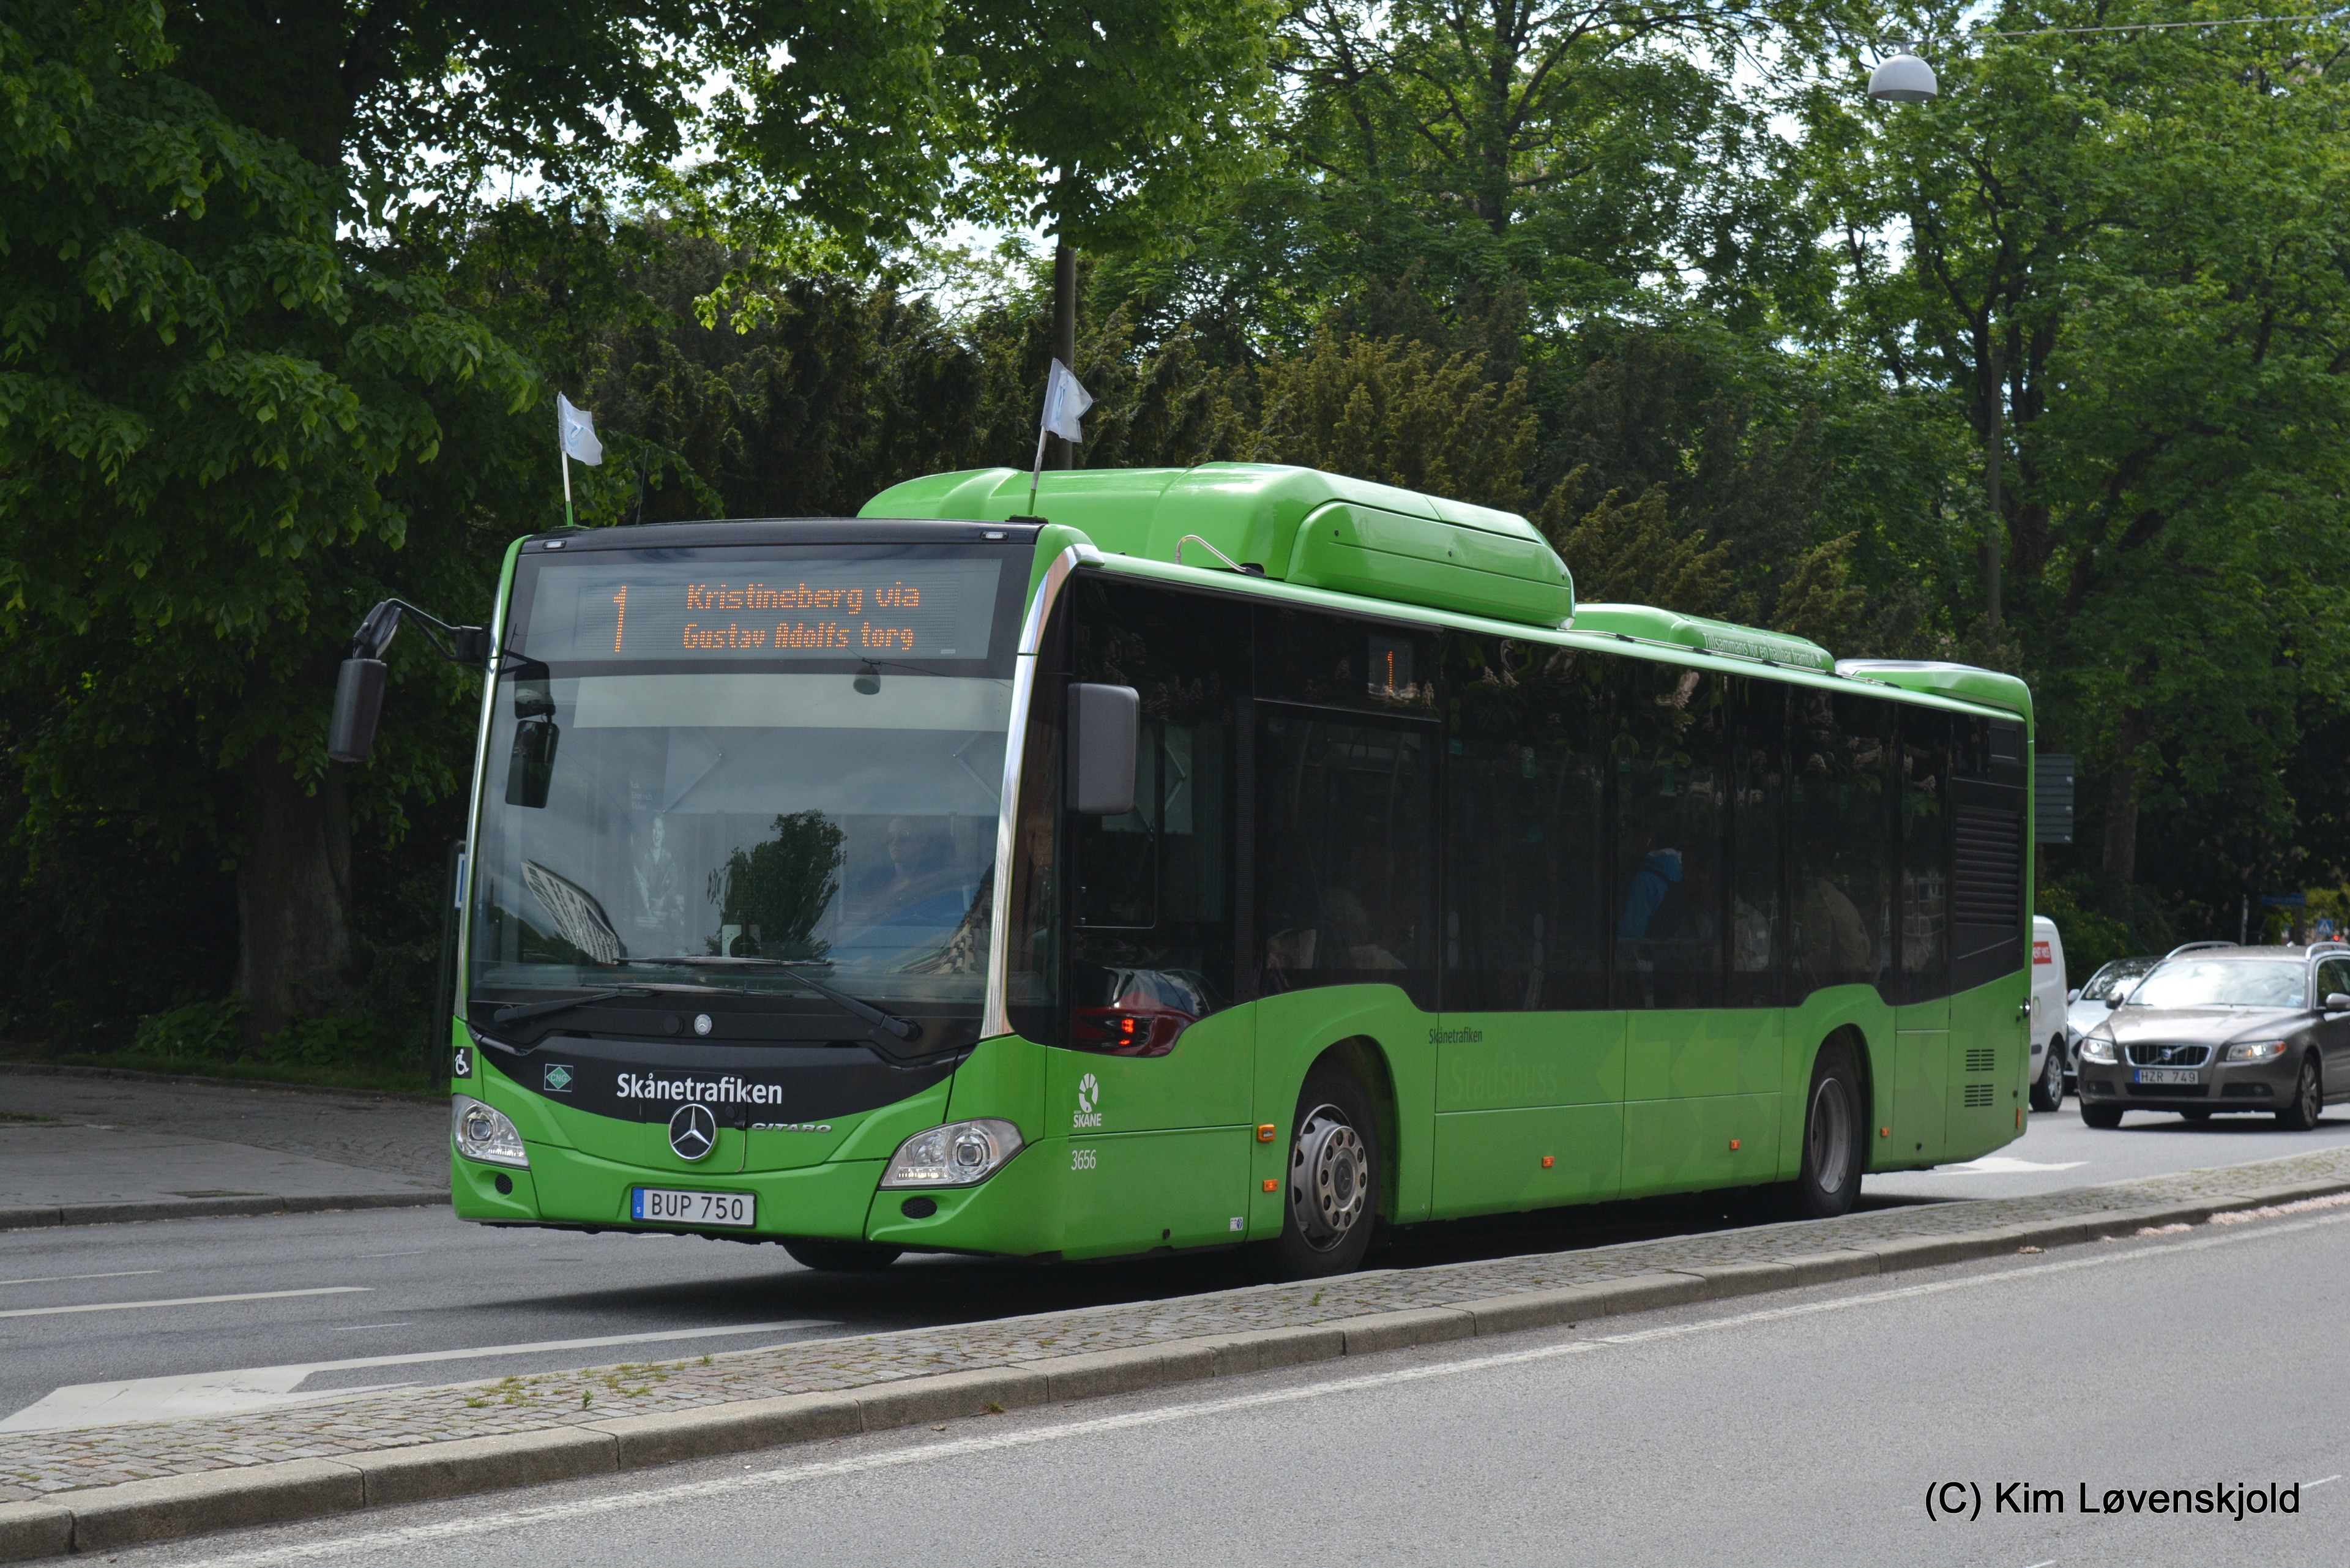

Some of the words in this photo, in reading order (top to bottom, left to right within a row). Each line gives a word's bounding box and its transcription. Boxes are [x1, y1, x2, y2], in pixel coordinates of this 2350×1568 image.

[686, 583, 863, 614] Kristineberg
[875, 581, 920, 607] via
[613, 585, 627, 652] 1
[682, 622, 766, 649] Gustav
[774, 621, 851, 648] Adolfs
[860, 621, 914, 651] torg
[1703, 633, 1748, 655] Tillsammans
[1759, 646, 1769, 659] en
[1387, 650, 1393, 692] 1
[1429, 1026, 1482, 1044] Skånetrafiken
[550, 1073, 567, 1083] CNG
[616, 1072, 783, 1105] Skånetrafiken
[2141, 1071, 2163, 1083] HZR
[2173, 1071, 2196, 1083] 749
[752, 1122, 832, 1133] CITARO
[1071, 1149, 1097, 1171] 3656
[651, 1193, 692, 1217] BUP
[701, 1196, 743, 1220] 750
